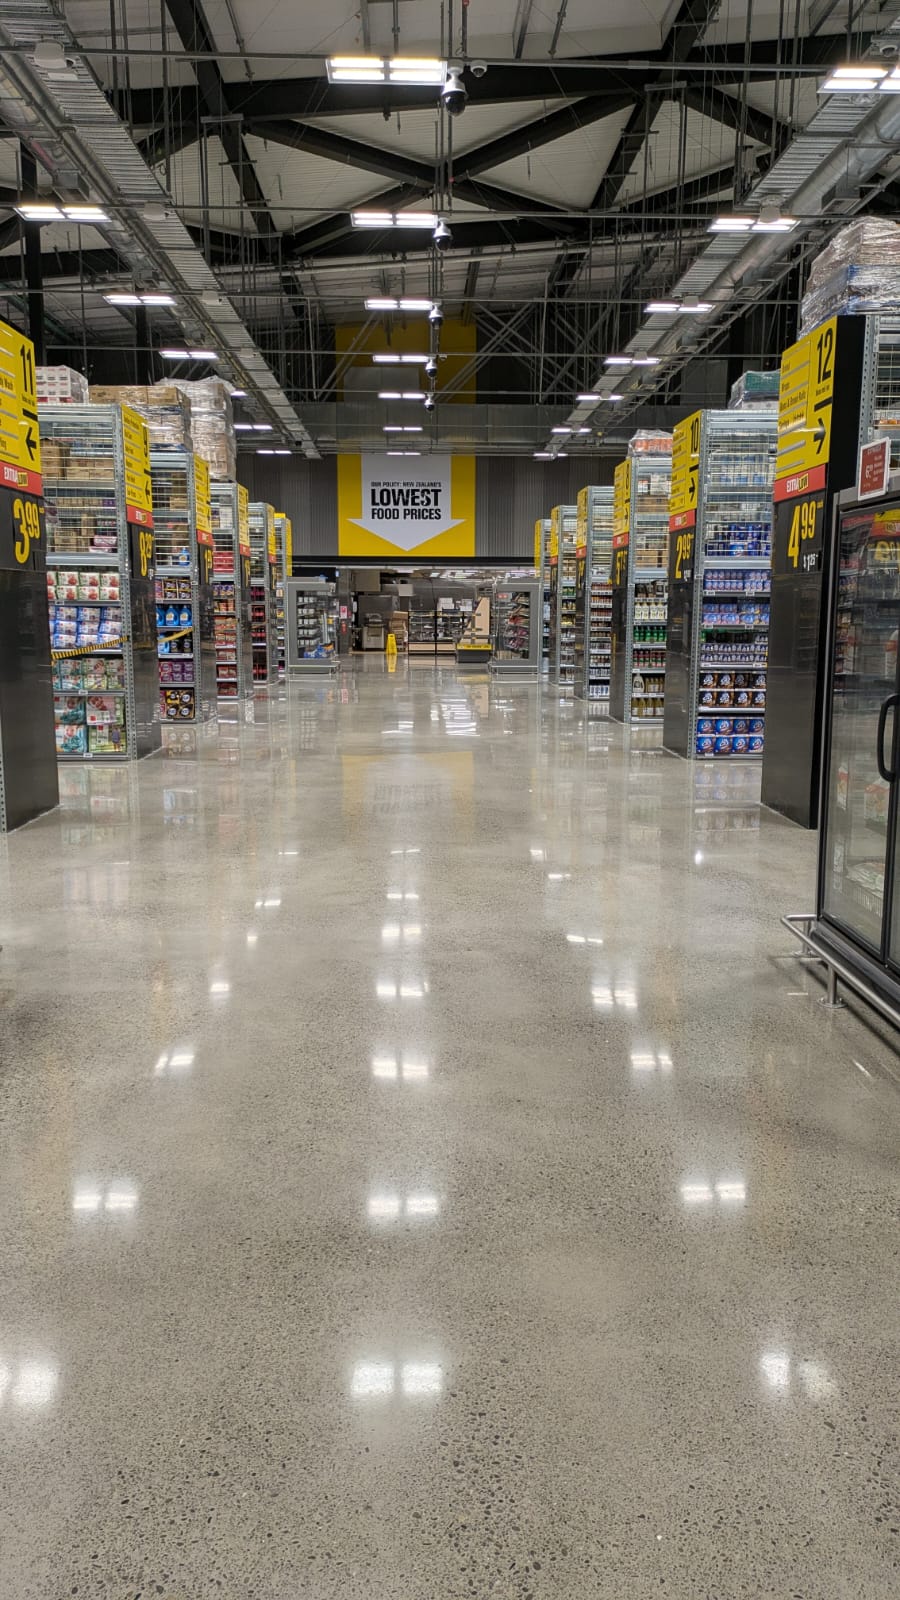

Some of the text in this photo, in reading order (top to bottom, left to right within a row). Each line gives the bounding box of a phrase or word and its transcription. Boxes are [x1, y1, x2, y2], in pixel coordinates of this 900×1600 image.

[20, 344, 33, 396] 11
[817, 327, 833, 385] 12
[690, 417, 699, 455] 10
[370, 488, 442, 507] LOWEST
[371, 508, 442, 520] FOOD PRICES
